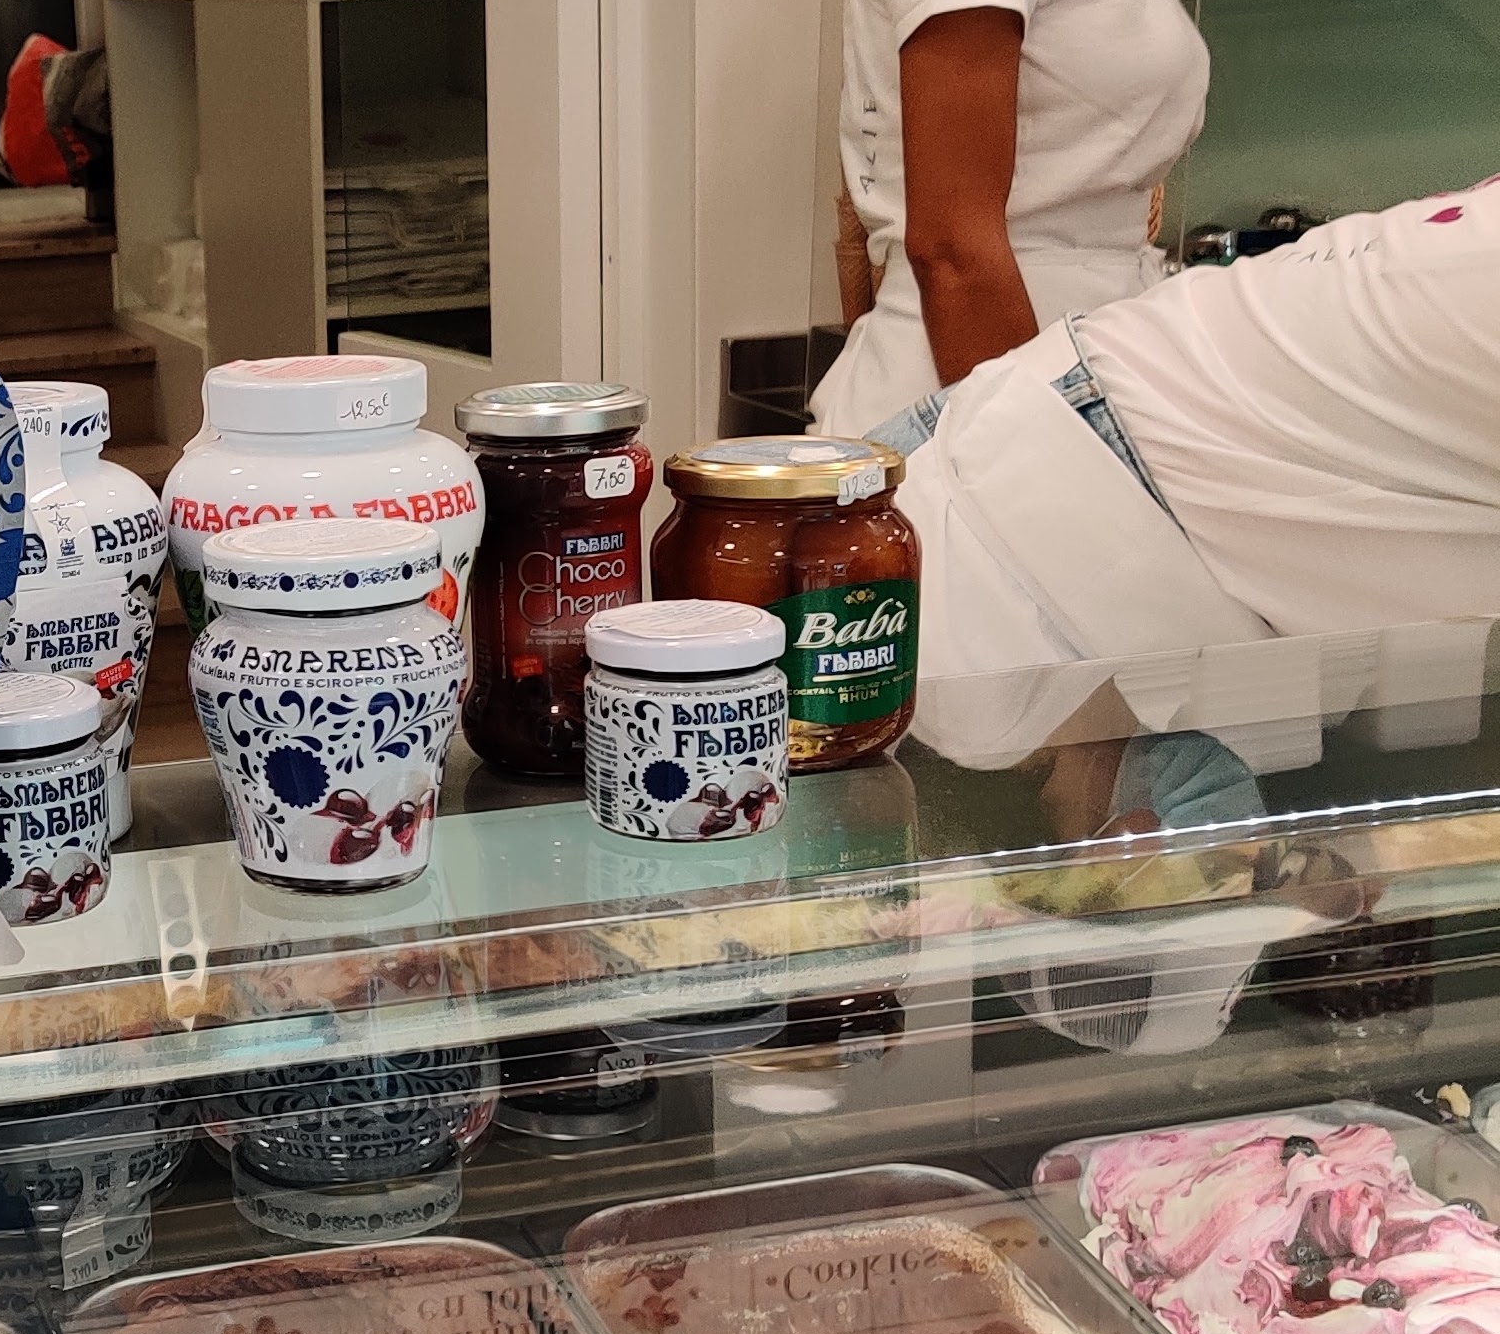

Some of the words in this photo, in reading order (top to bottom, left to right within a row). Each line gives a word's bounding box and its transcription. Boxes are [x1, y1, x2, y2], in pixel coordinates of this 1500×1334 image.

[22, 416, 43, 435] 240
[44, 420, 51, 436] g
[565, 532, 624, 555] FABBRI
[518, 551, 626, 593] Choco
[518, 583, 626, 626] Cherry
[25, 611, 121, 640] AMARENA
[793, 598, 908, 649] Babà
[25, 628, 120, 662] FABBRI
[239, 644, 425, 674] AMARENA
[817, 643, 895, 674] FABBRI
[50, 656, 94, 674] RECETTES
[240, 674, 291, 688] FRUTTO
[294, 678, 303, 688] E
[306, 676, 386, 689] SCIROPPO
[392, 667, 441, 685] FRUCHT
[672, 688, 786, 726] AMARENA
[839, 688, 879, 704] RHUM
[672, 713, 786, 758] FABBRI
